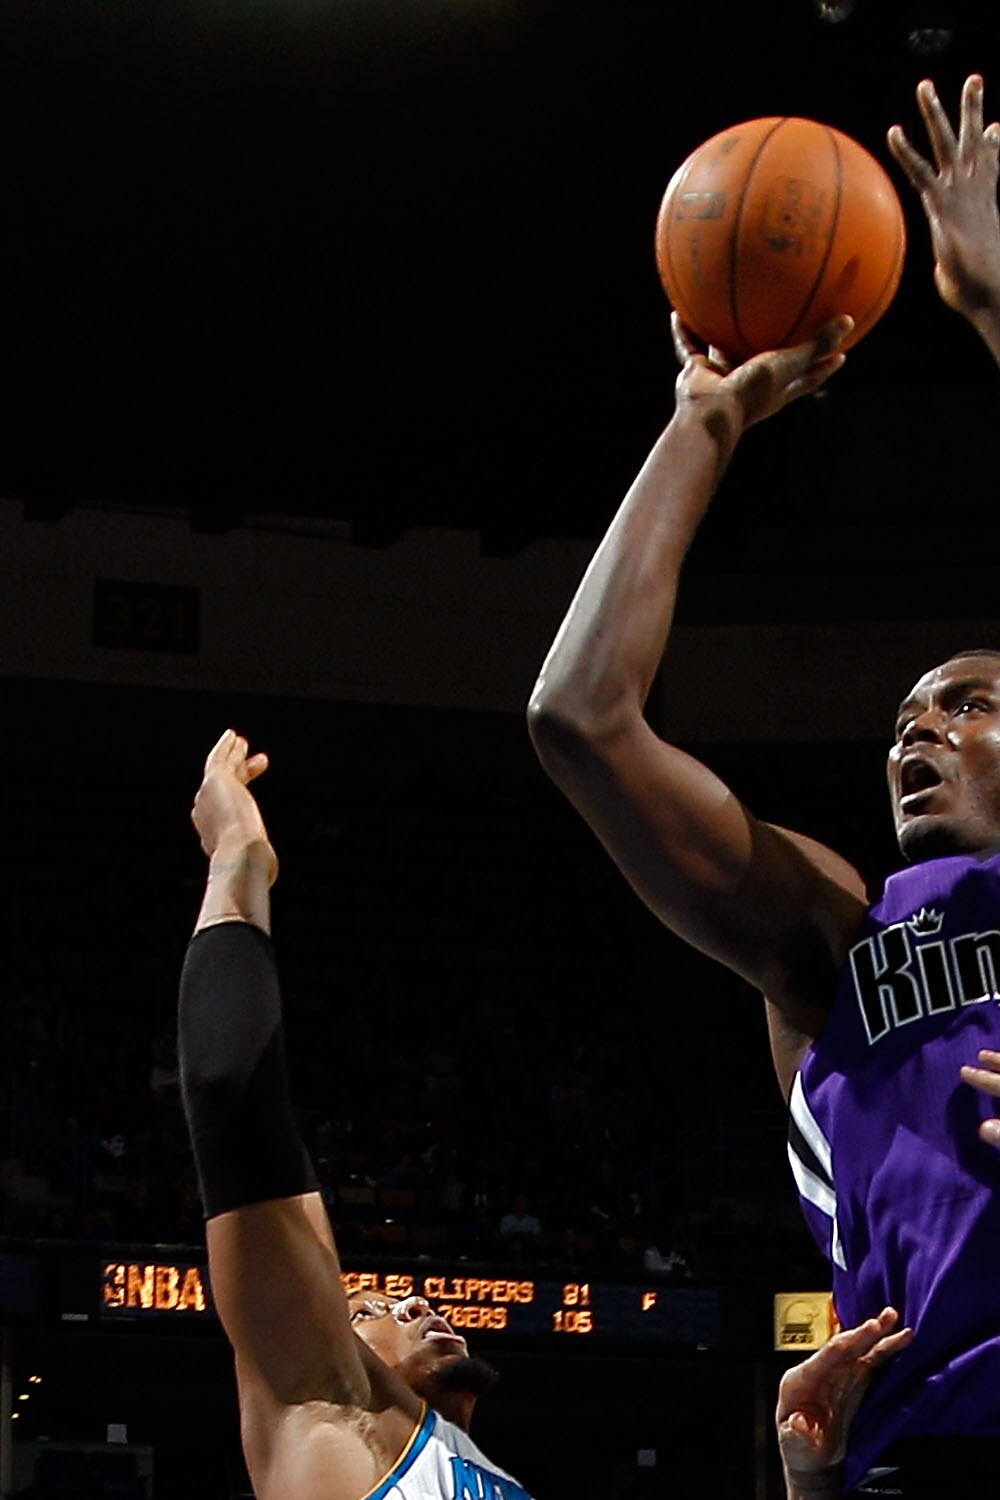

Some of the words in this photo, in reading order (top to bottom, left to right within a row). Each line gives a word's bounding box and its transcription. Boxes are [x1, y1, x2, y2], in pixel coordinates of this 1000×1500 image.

[424, 1276, 534, 1303] CLIPPERS
[563, 1284, 590, 1305] 81
[552, 1310, 594, 1333] 105
